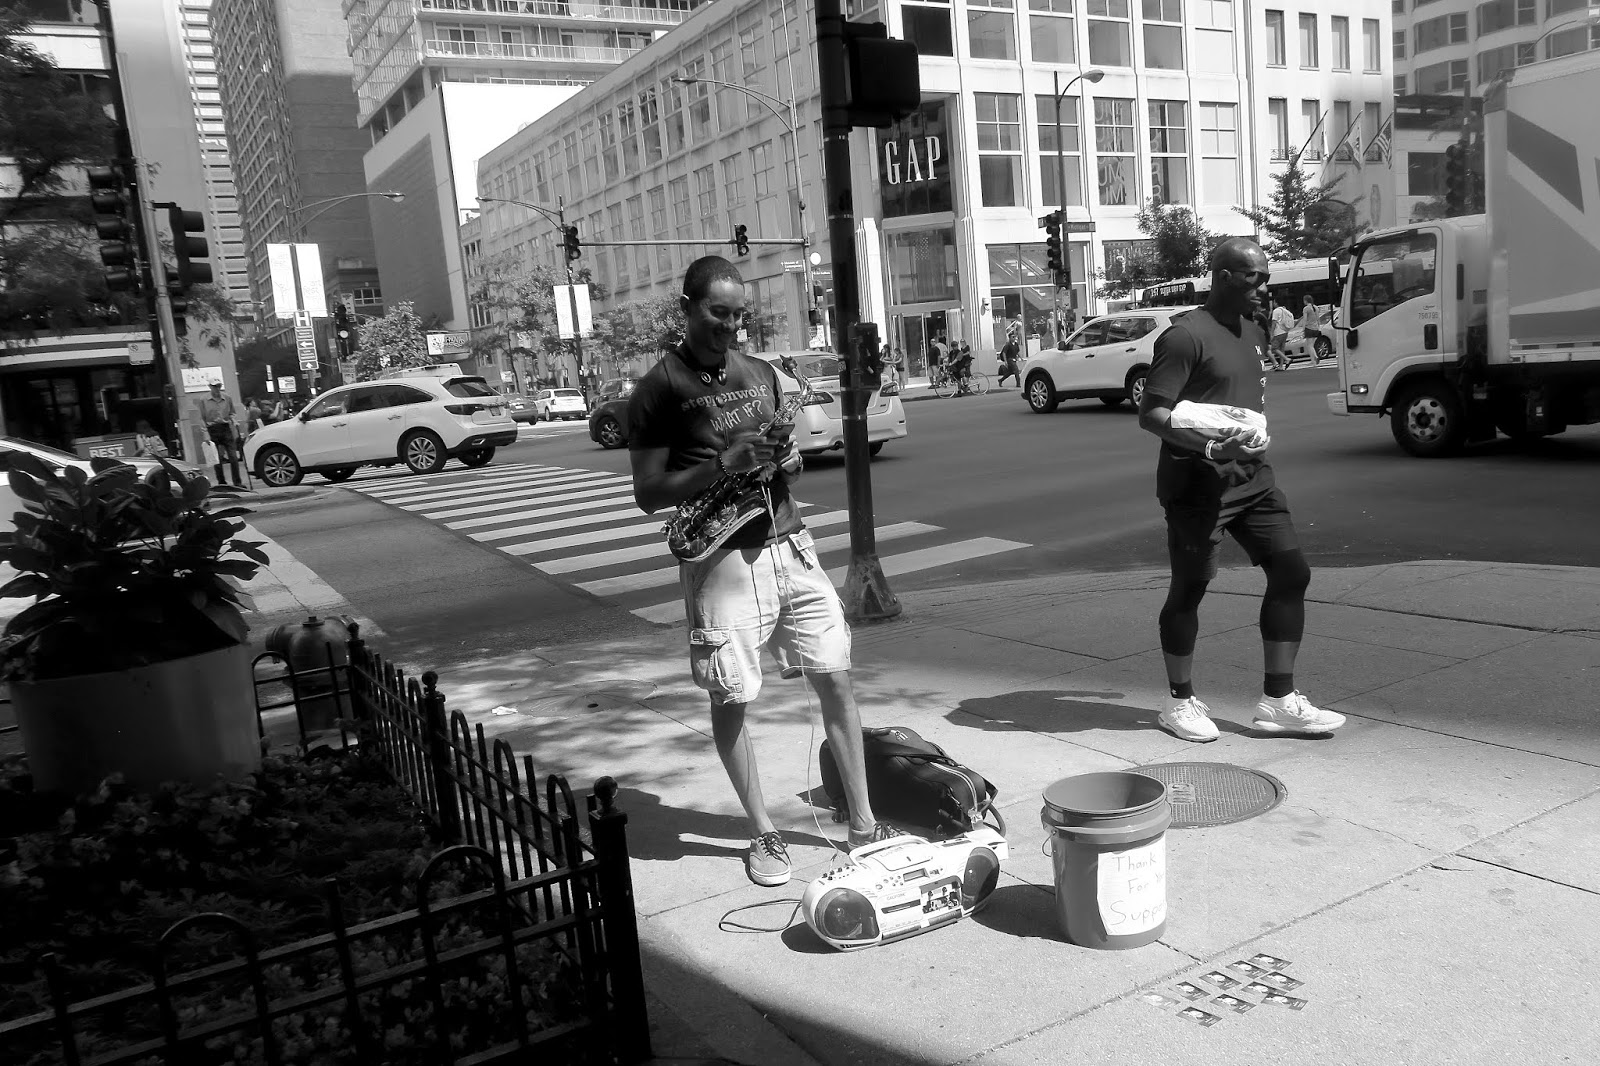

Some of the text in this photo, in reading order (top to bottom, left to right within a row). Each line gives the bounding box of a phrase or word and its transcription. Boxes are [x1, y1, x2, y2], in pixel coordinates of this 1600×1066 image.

[885, 136, 940, 185] GAP
[1112, 852, 1156, 873] Thank
[1128, 878, 1149, 894] For
